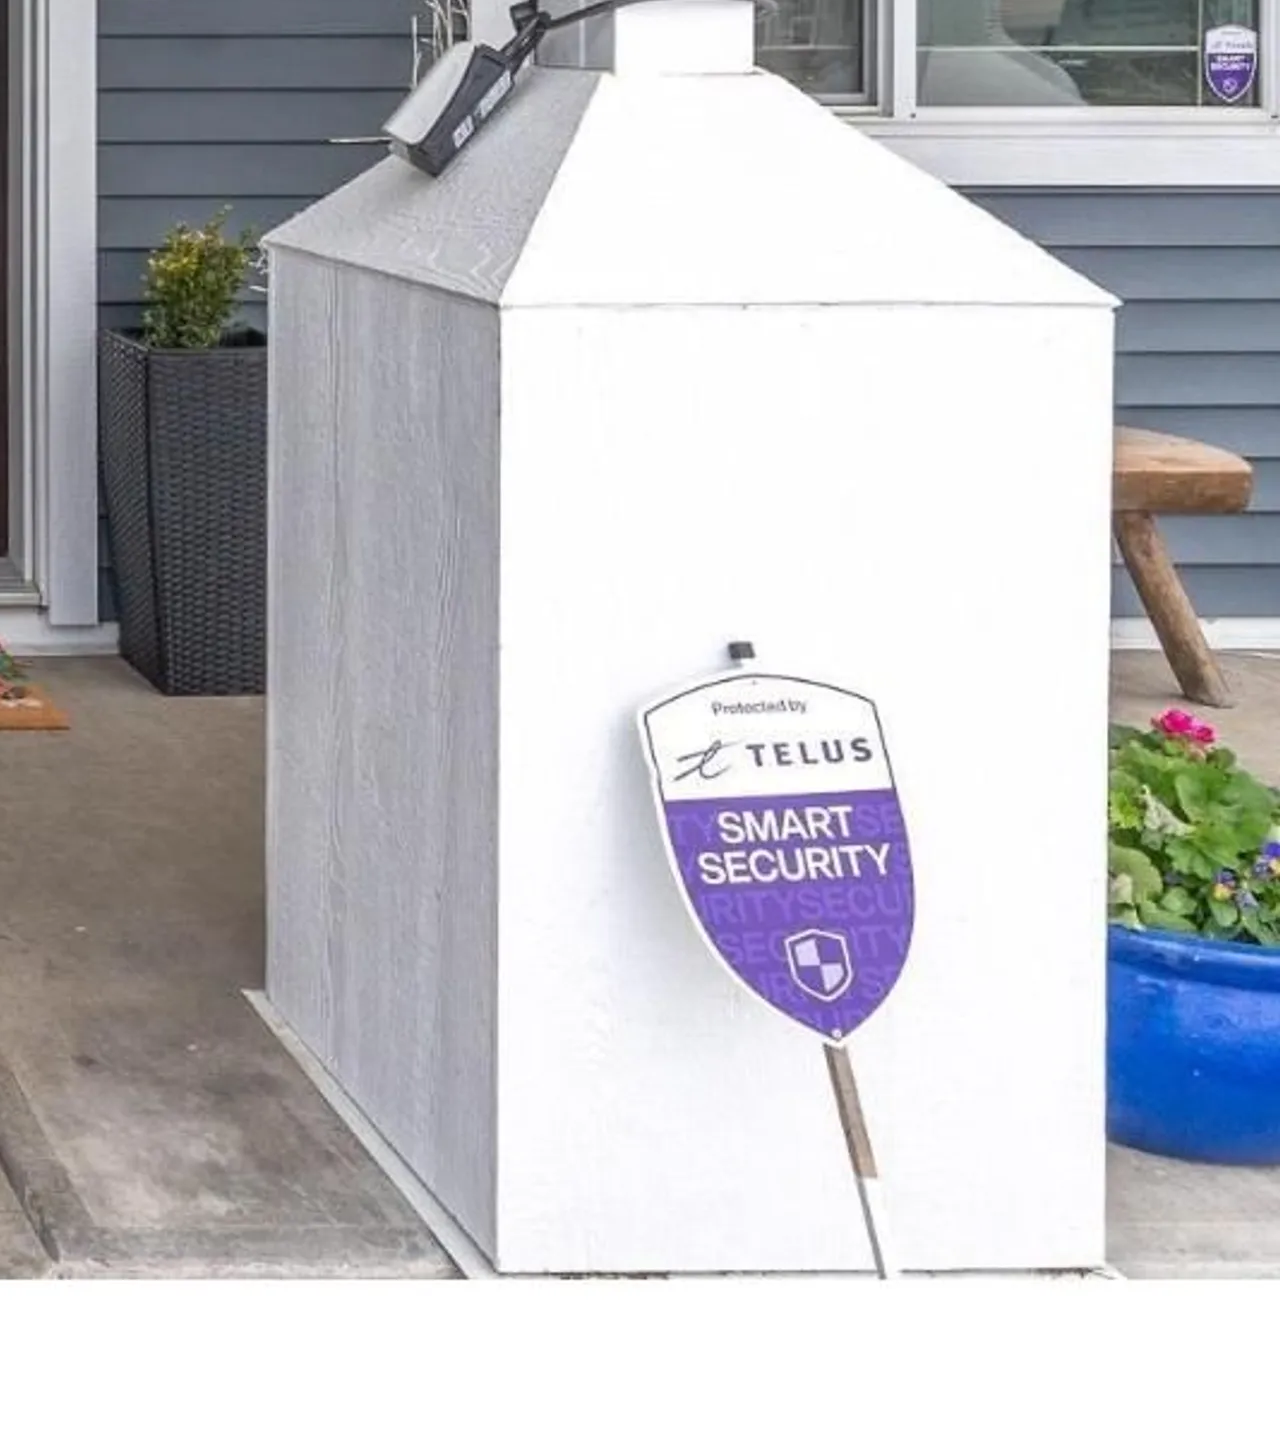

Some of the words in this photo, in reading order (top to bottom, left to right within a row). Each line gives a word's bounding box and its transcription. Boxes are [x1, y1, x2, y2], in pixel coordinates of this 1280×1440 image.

[711, 699, 787, 716] Protected
[788, 698, 808, 714] by
[745, 736, 874, 767] TELUS
[717, 805, 853, 844] SMART
[698, 843, 891, 885] SECURITY
